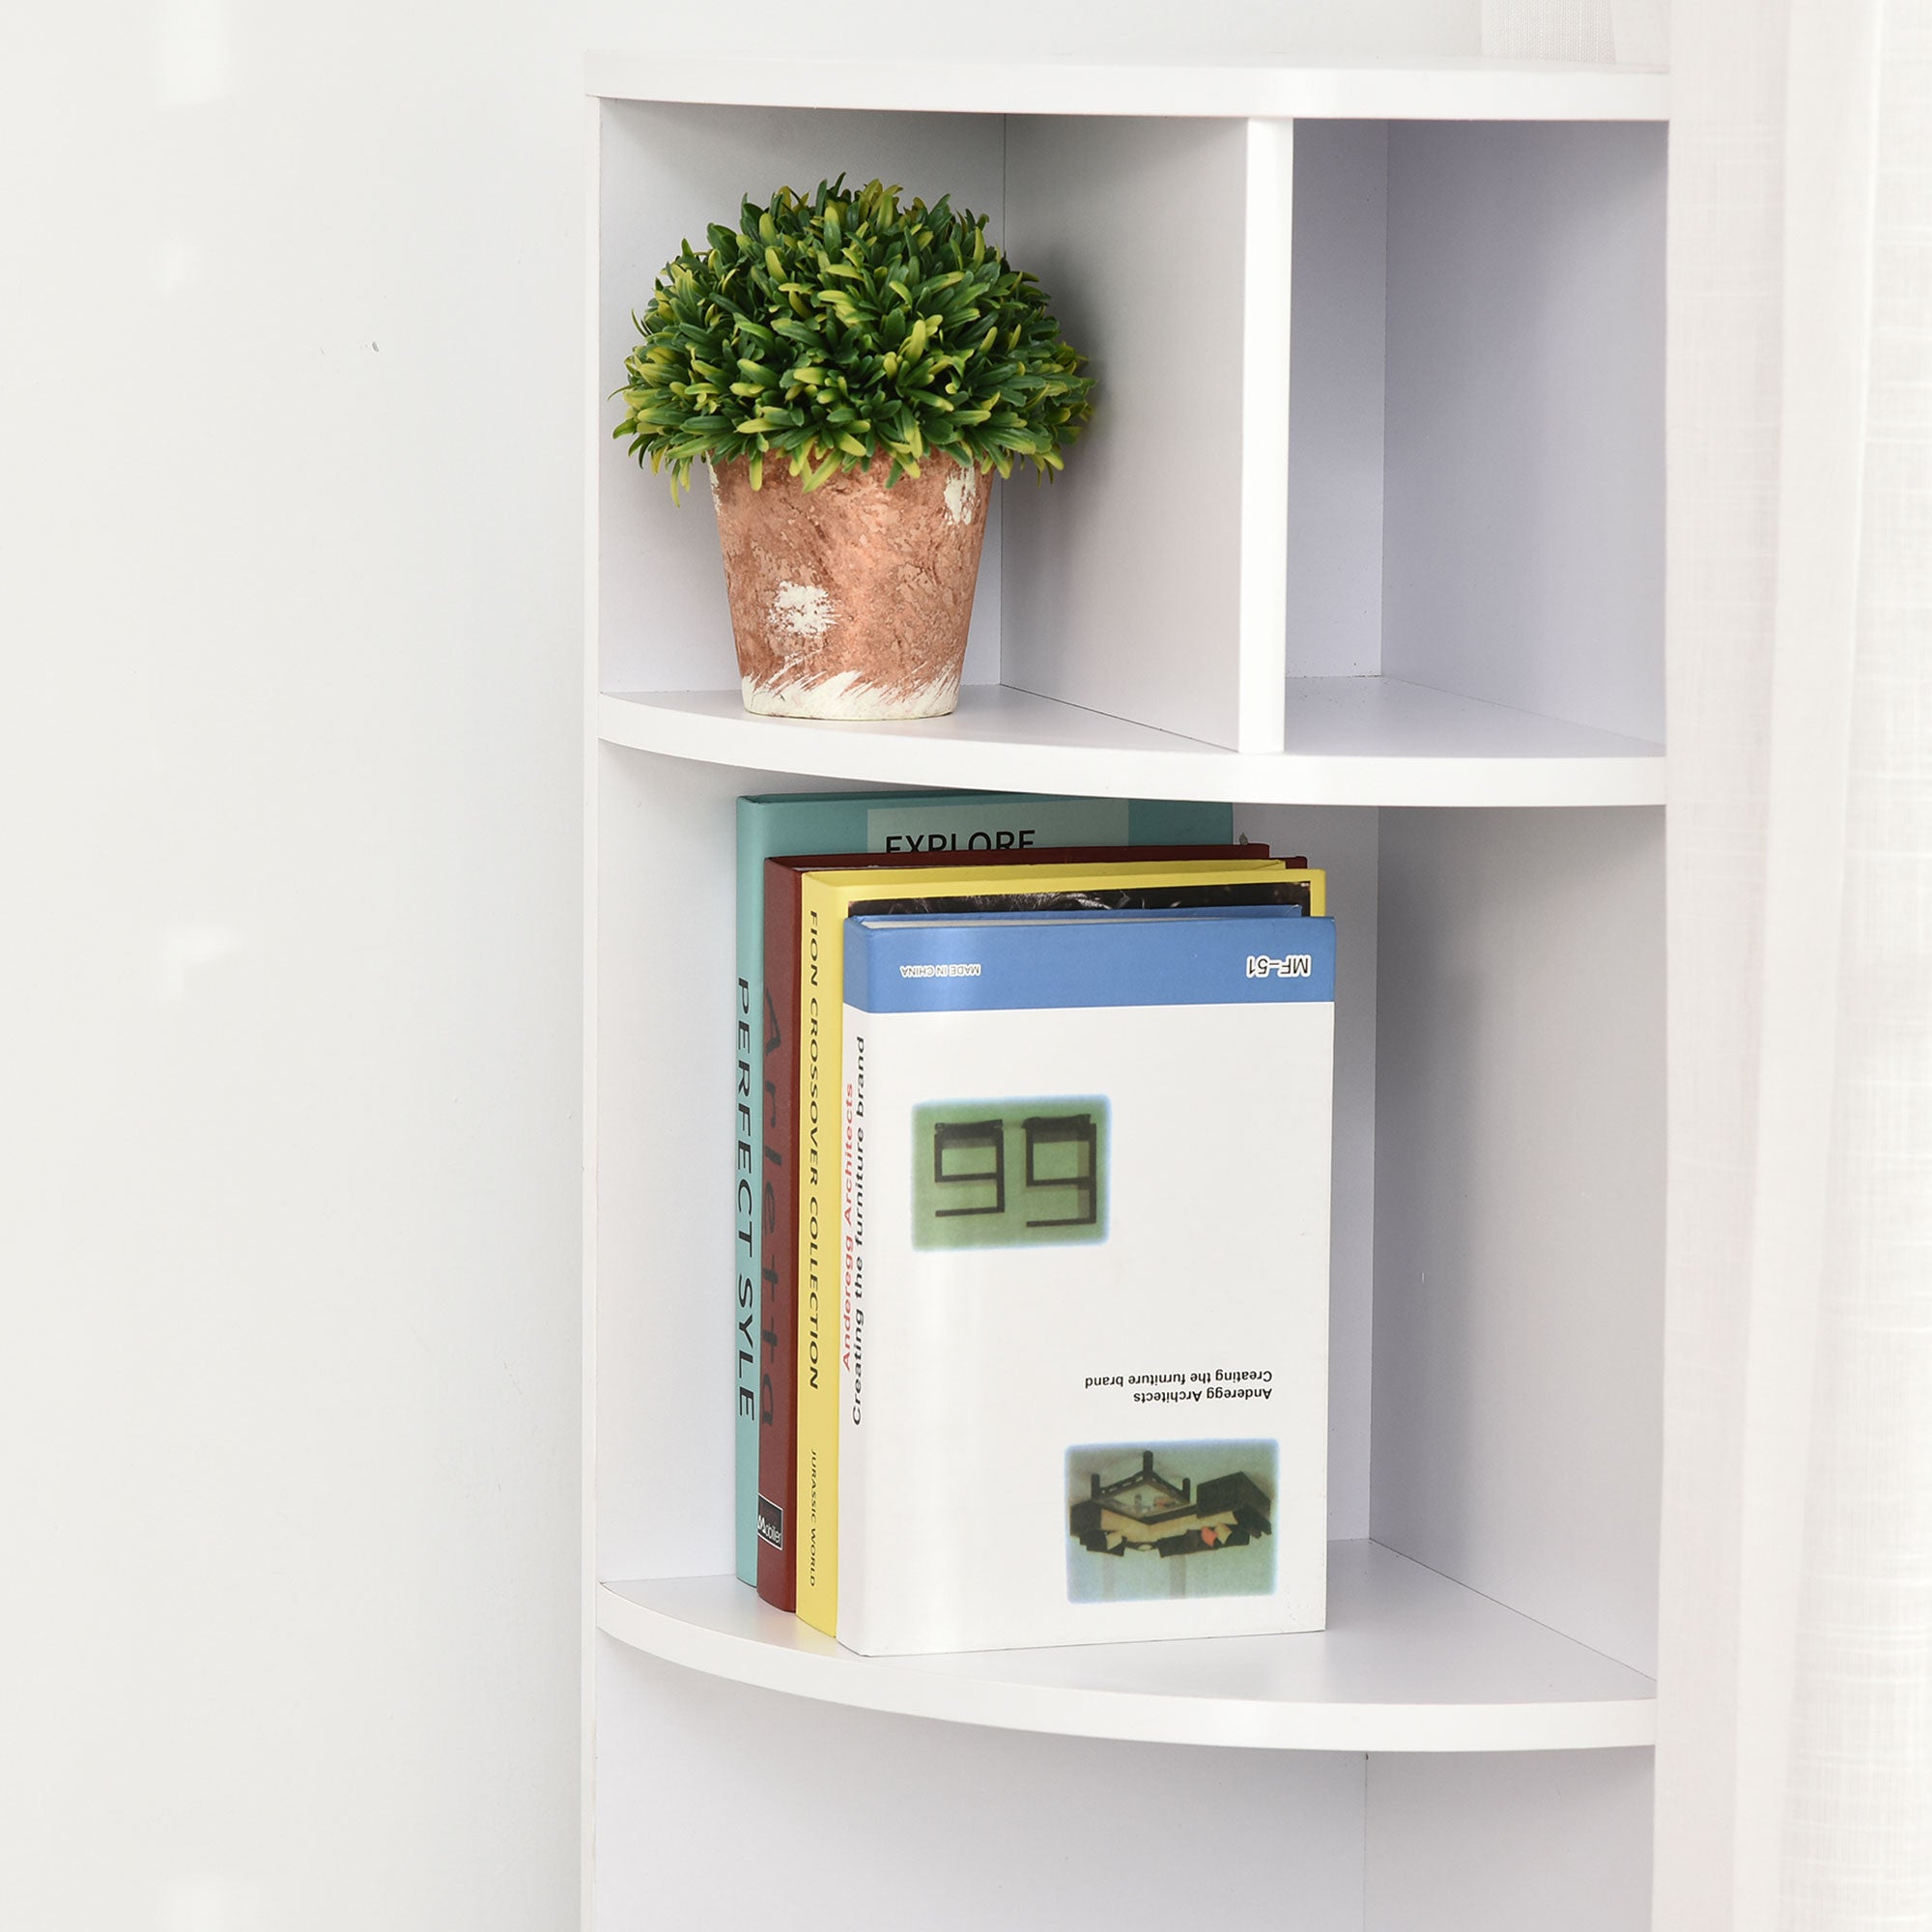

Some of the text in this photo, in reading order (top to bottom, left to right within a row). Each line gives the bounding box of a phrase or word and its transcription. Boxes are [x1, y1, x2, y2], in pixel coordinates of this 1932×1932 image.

[900, 964, 980, 977] MADE IN CHINA
[1247, 956, 1310, 977] MF-51
[738, 978, 754, 1420] PERFECT SYLE
[762, 987, 781, 1425] Arletta
[810, 910, 818, 1390] FION CROSSOVER COLLECTION
[842, 1083, 854, 1372] Anderegg Architects
[852, 1036, 866, 1426] Creating the furniture brand
[1085, 1369, 1273, 1389] Creating the furniture brand
[1133, 1387, 1273, 1404] Anderegg Architects
